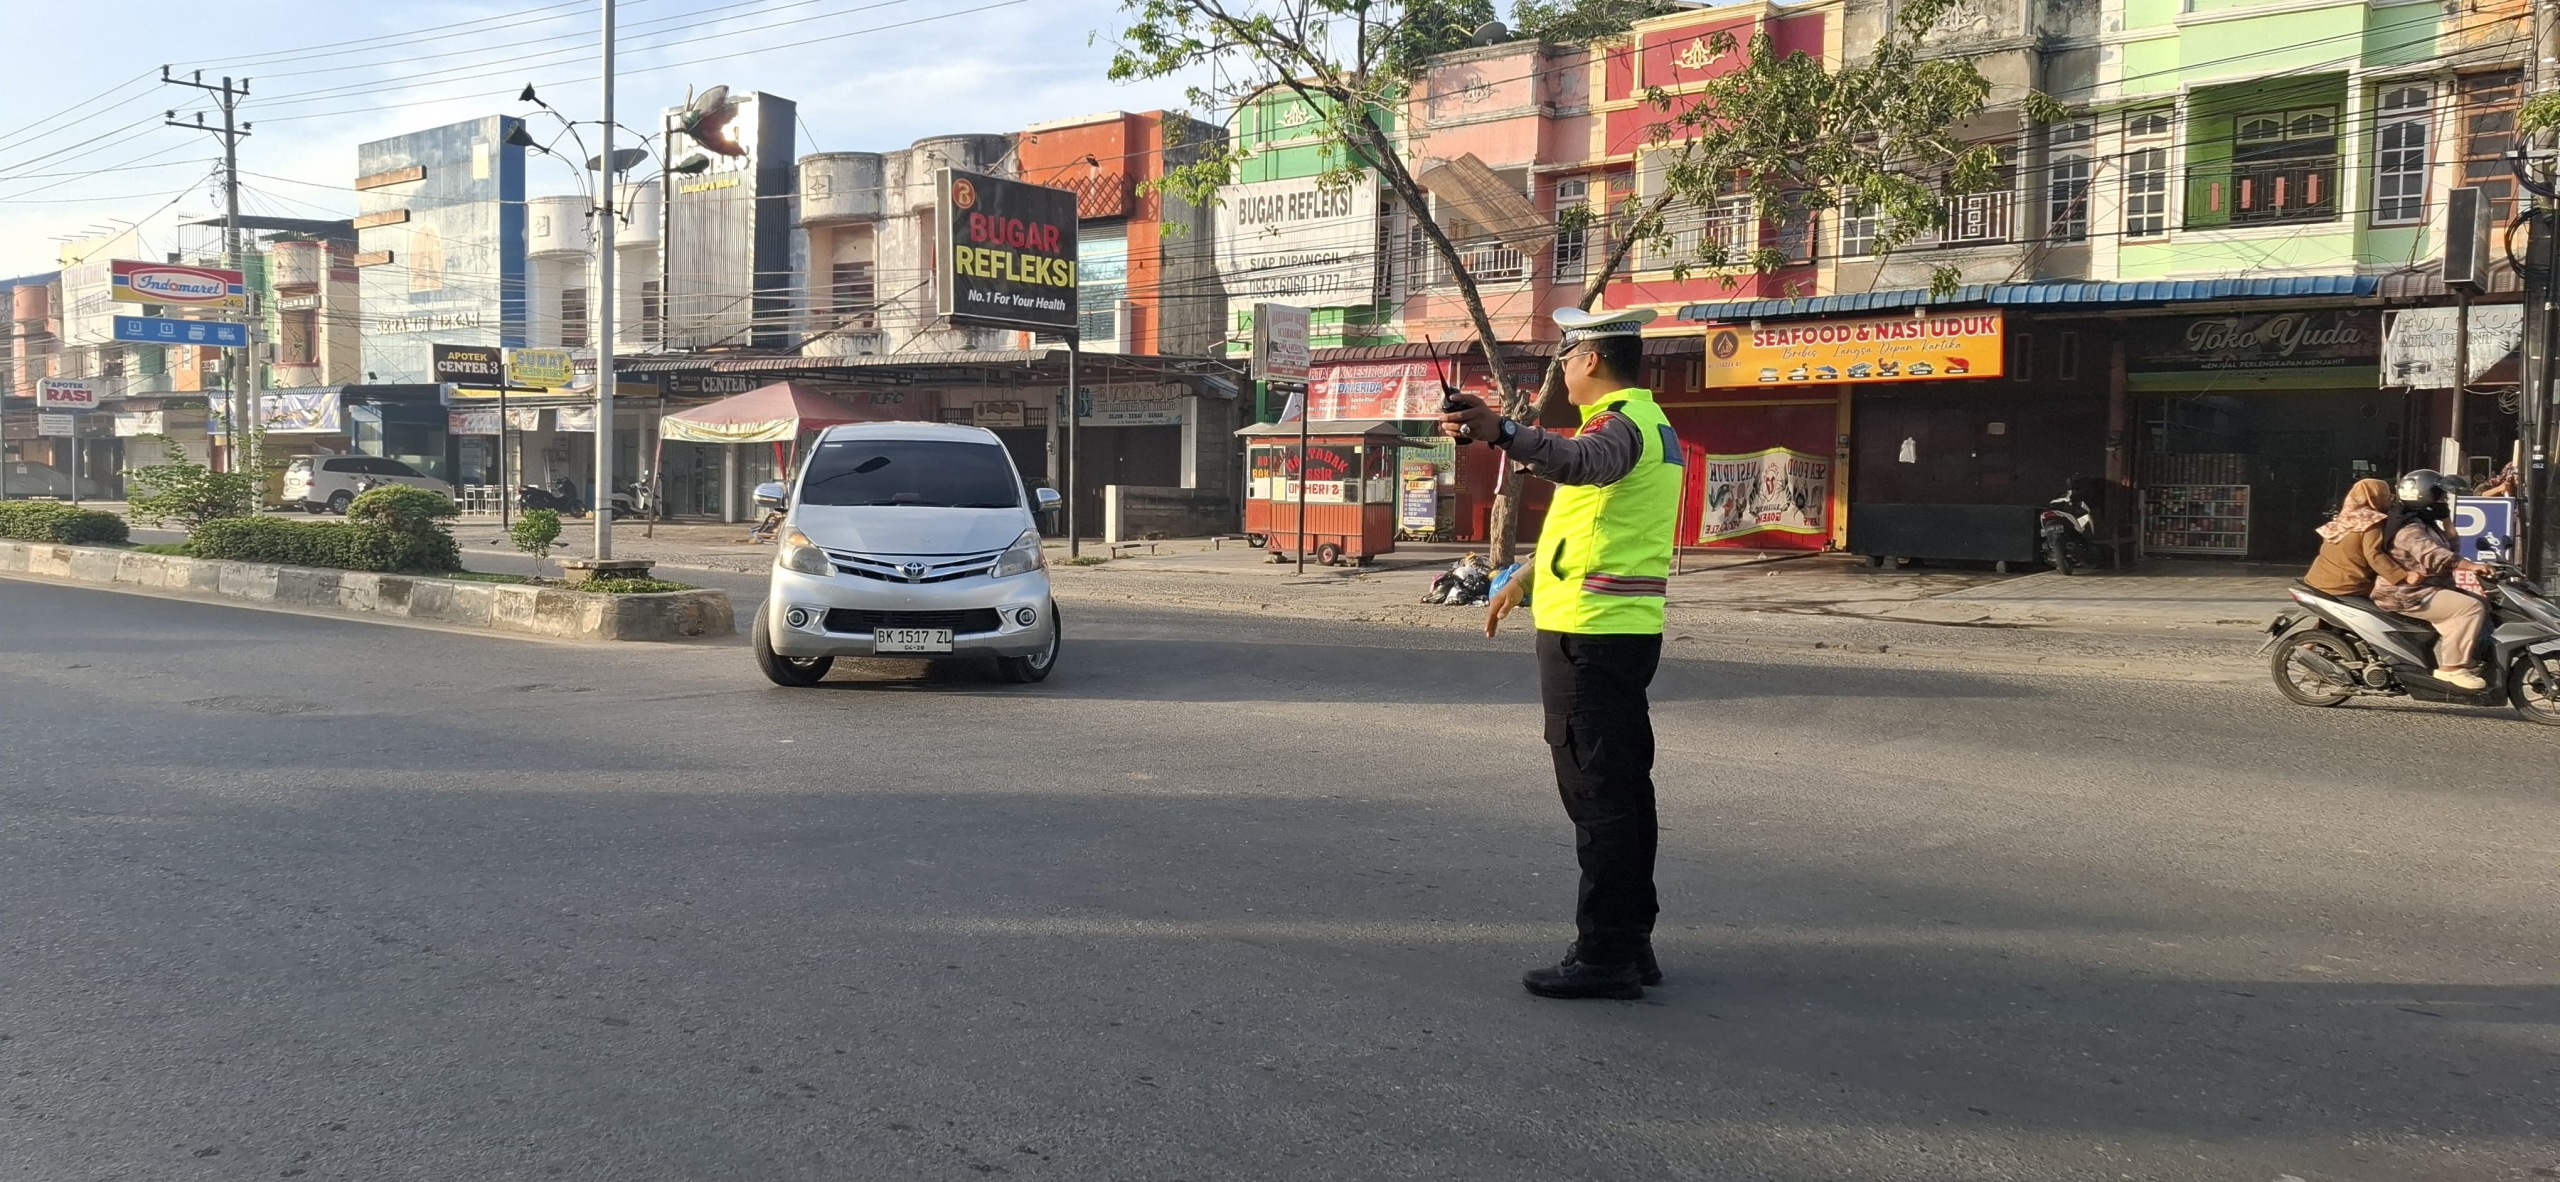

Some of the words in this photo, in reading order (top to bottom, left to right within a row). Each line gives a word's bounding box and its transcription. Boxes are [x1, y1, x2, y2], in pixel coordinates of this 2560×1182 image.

[1239, 194, 1283, 226] BUGAR
[1288, 187, 1353, 221] REFLEKSI
[970, 212, 1060, 253] BUGAR
[956, 245, 1075, 288] REFLEKSI
[1250, 257, 1275, 271] SIAP
[1279, 252, 1341, 268] DIPANGGIL
[138, 275, 221, 295] Indomaret
[1313, 273, 1340, 295] 1777
[994, 292, 1010, 304] For
[1012, 294, 1034, 308] Your
[1036, 297, 1066, 311] Health
[1753, 325, 1851, 348] SEAFOOD
[1855, 321, 1871, 341] &
[1875, 318, 1925, 341] NASI
[1930, 315, 1996, 337] UDUK
[2186, 319, 2258, 351] Toko
[2269, 315, 2362, 357] Yuda
[447, 352, 488, 362] APOTEK
[1782, 346, 1818, 360] Brebes
[1833, 343, 1873, 361] Langsa
[1880, 340, 1916, 358] Depan
[1921, 338, 1963, 352] Kartika
[437, 361, 489, 374] CENTER
[490, 361, 499, 375] 3
[516, 350, 567, 369] SUNAT
[2240, 360, 2303, 368] PERLENGKAPAN
[2305, 358, 2346, 366] MENJAHIT
[1420, 363, 1428, 376] 2
[51, 381, 84, 389] APOTEK
[702, 376, 747, 392] CENTER
[1097, 382, 1178, 402] EVEREST
[1355, 381, 1383, 393] ERIDA
[46, 388, 93, 402] RASI
[869, 393, 905, 404] KFC
[1286, 447, 1349, 473] MATABAK
[1305, 468, 1332, 480] ESIR
[1305, 484, 1329, 495] HERI
[1331, 485, 1340, 495] 2
[878, 630, 894, 643] BK
[898, 630, 929, 643] 1517
[936, 630, 952, 644] ZL
